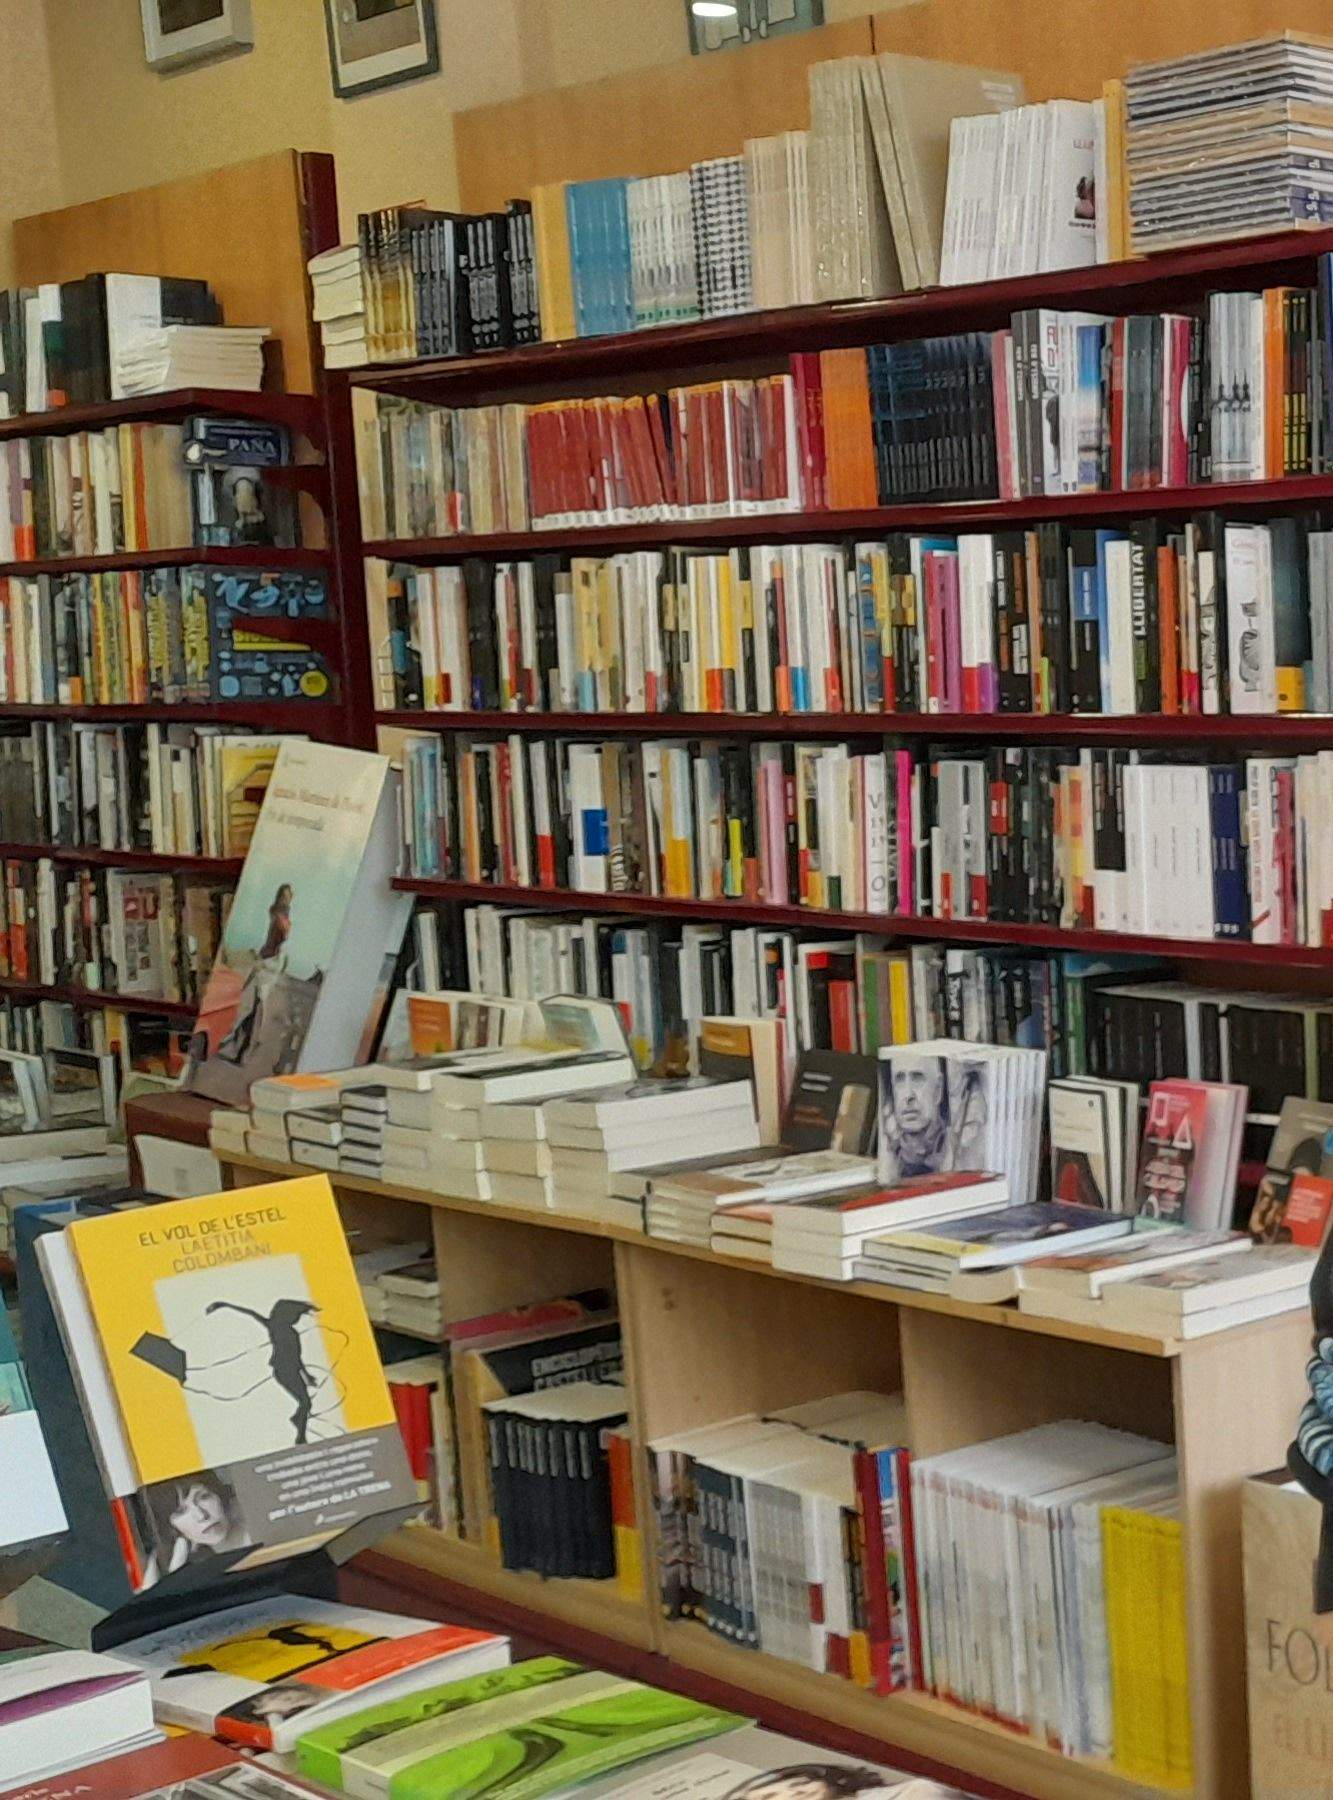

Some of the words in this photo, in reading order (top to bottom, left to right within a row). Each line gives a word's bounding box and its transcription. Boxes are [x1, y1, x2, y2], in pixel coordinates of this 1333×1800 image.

[138, 1231, 159, 1246] EL
[163, 1225, 195, 1242] VOL
[198, 1219, 218, 1236] DE
[225, 1207, 287, 1231] L'ESTEL
[180, 1230, 257, 1256] LAETITIA
[172, 1244, 272, 1275] COLOMBANI
